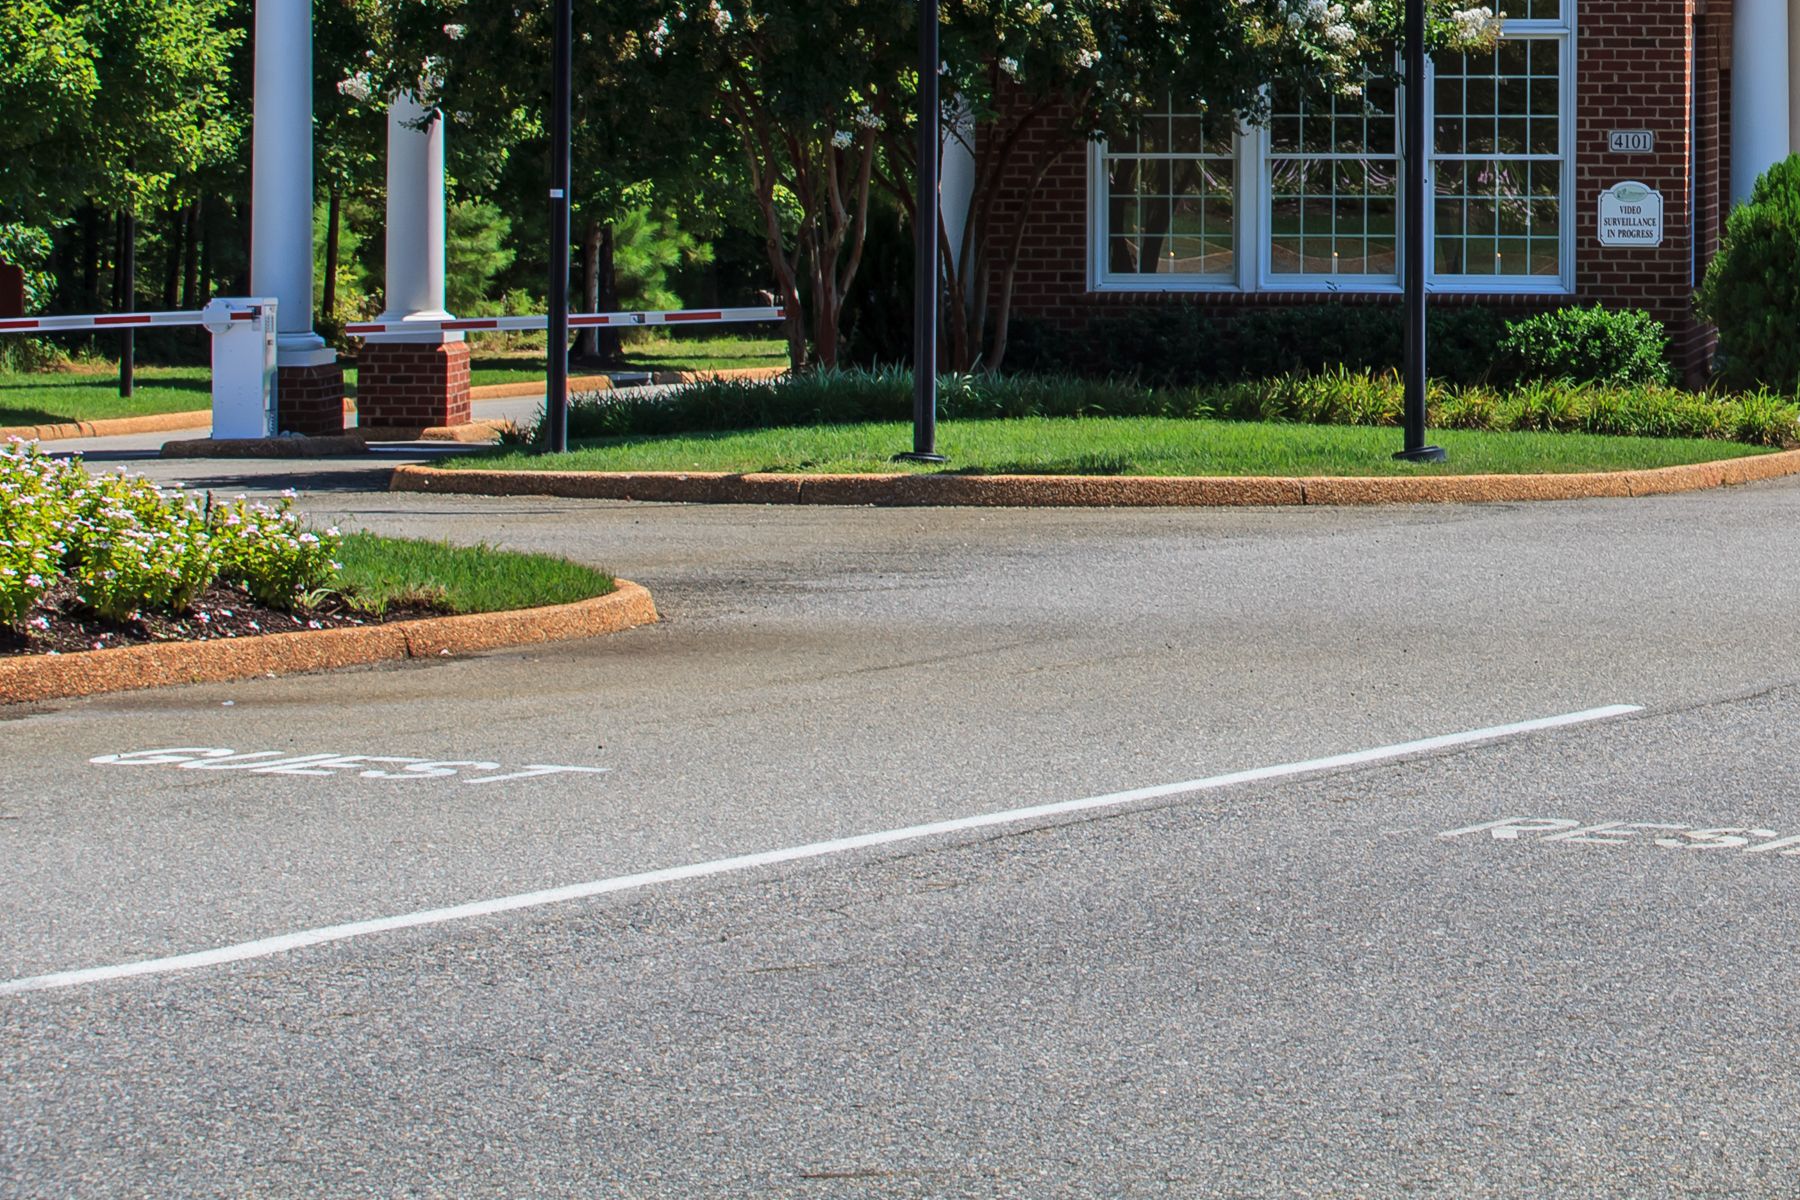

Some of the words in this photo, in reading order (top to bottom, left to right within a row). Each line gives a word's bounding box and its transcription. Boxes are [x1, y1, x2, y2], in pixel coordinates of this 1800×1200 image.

[1614, 134, 1648, 149] 4101
[1619, 205, 1642, 215] VIDEO
[1604, 218, 1656, 226] SURVEILLANCE
[1607, 229, 1616, 238] IN
[1617, 229, 1654, 238] PROGRESS
[88, 747, 614, 784] GUEST
